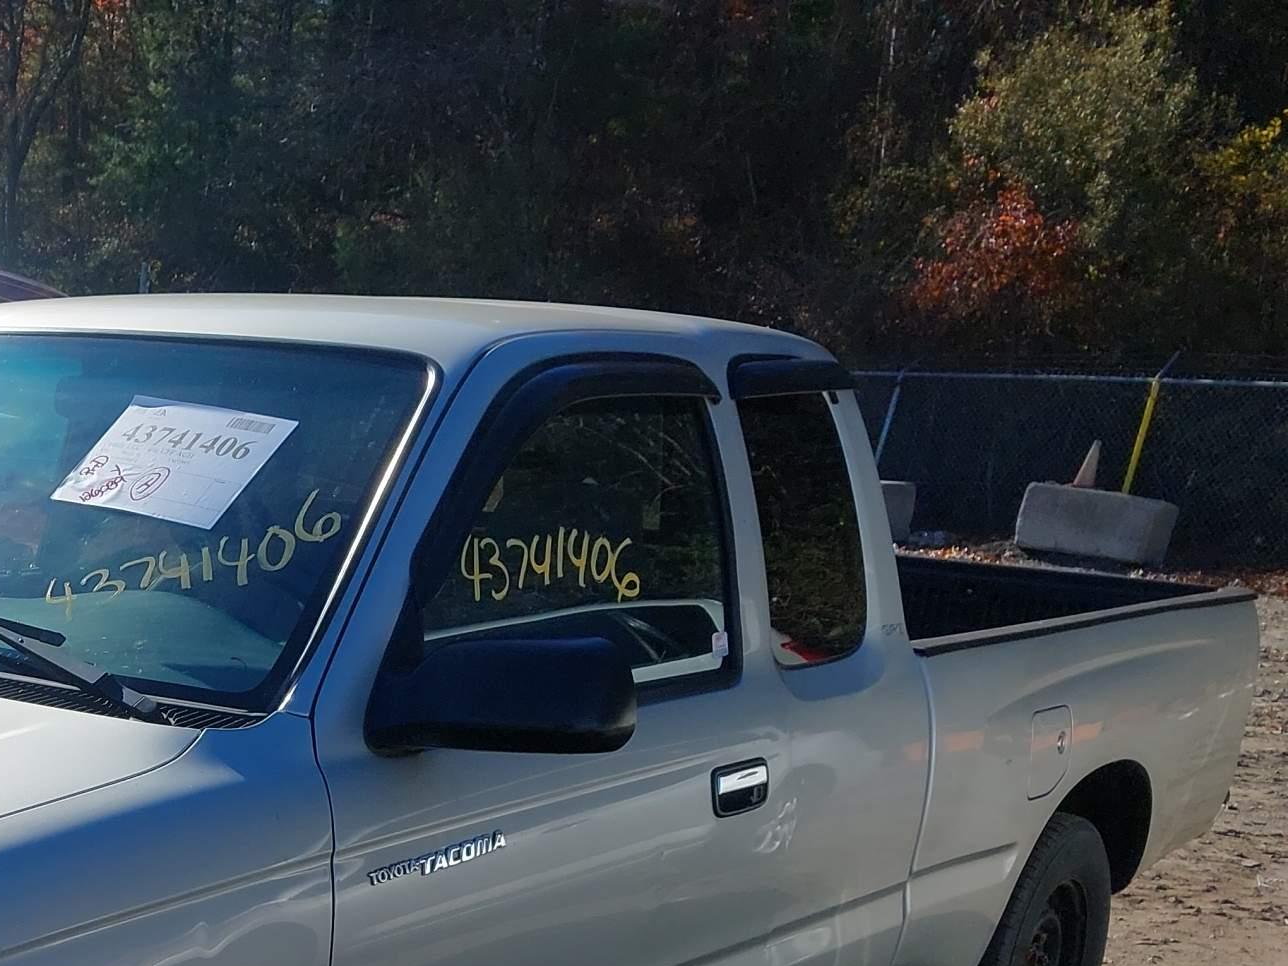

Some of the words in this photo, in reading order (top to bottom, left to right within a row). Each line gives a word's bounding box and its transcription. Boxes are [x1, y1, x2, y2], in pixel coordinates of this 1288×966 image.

[121, 423, 257, 460] 43741406
[45, 488, 342, 621] 43741406
[461, 526, 640, 603] 43741406
[367, 860, 420, 886] TOYOTA
[419, 829, 507, 876] TACOMA
